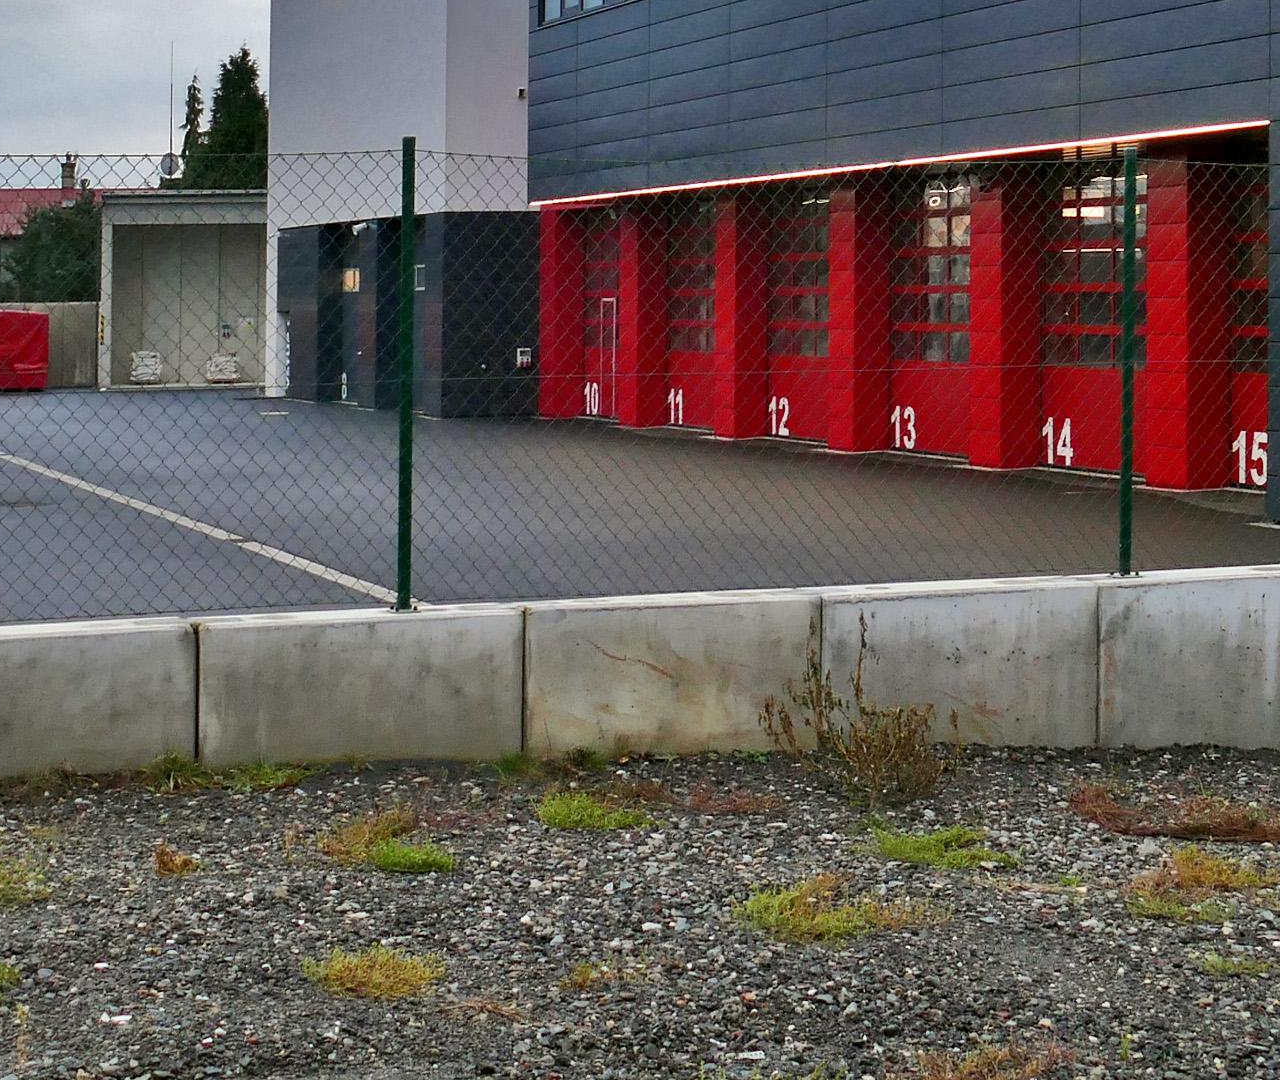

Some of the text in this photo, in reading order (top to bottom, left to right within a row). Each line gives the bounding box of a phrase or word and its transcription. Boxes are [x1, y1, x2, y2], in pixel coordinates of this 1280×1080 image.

[583, 382, 599, 415] 10
[668, 388, 683, 425] 11
[768, 396, 789, 436] 12
[890, 405, 917, 449] 13
[1042, 417, 1073, 466] 14
[1232, 430, 1268, 486] 15
